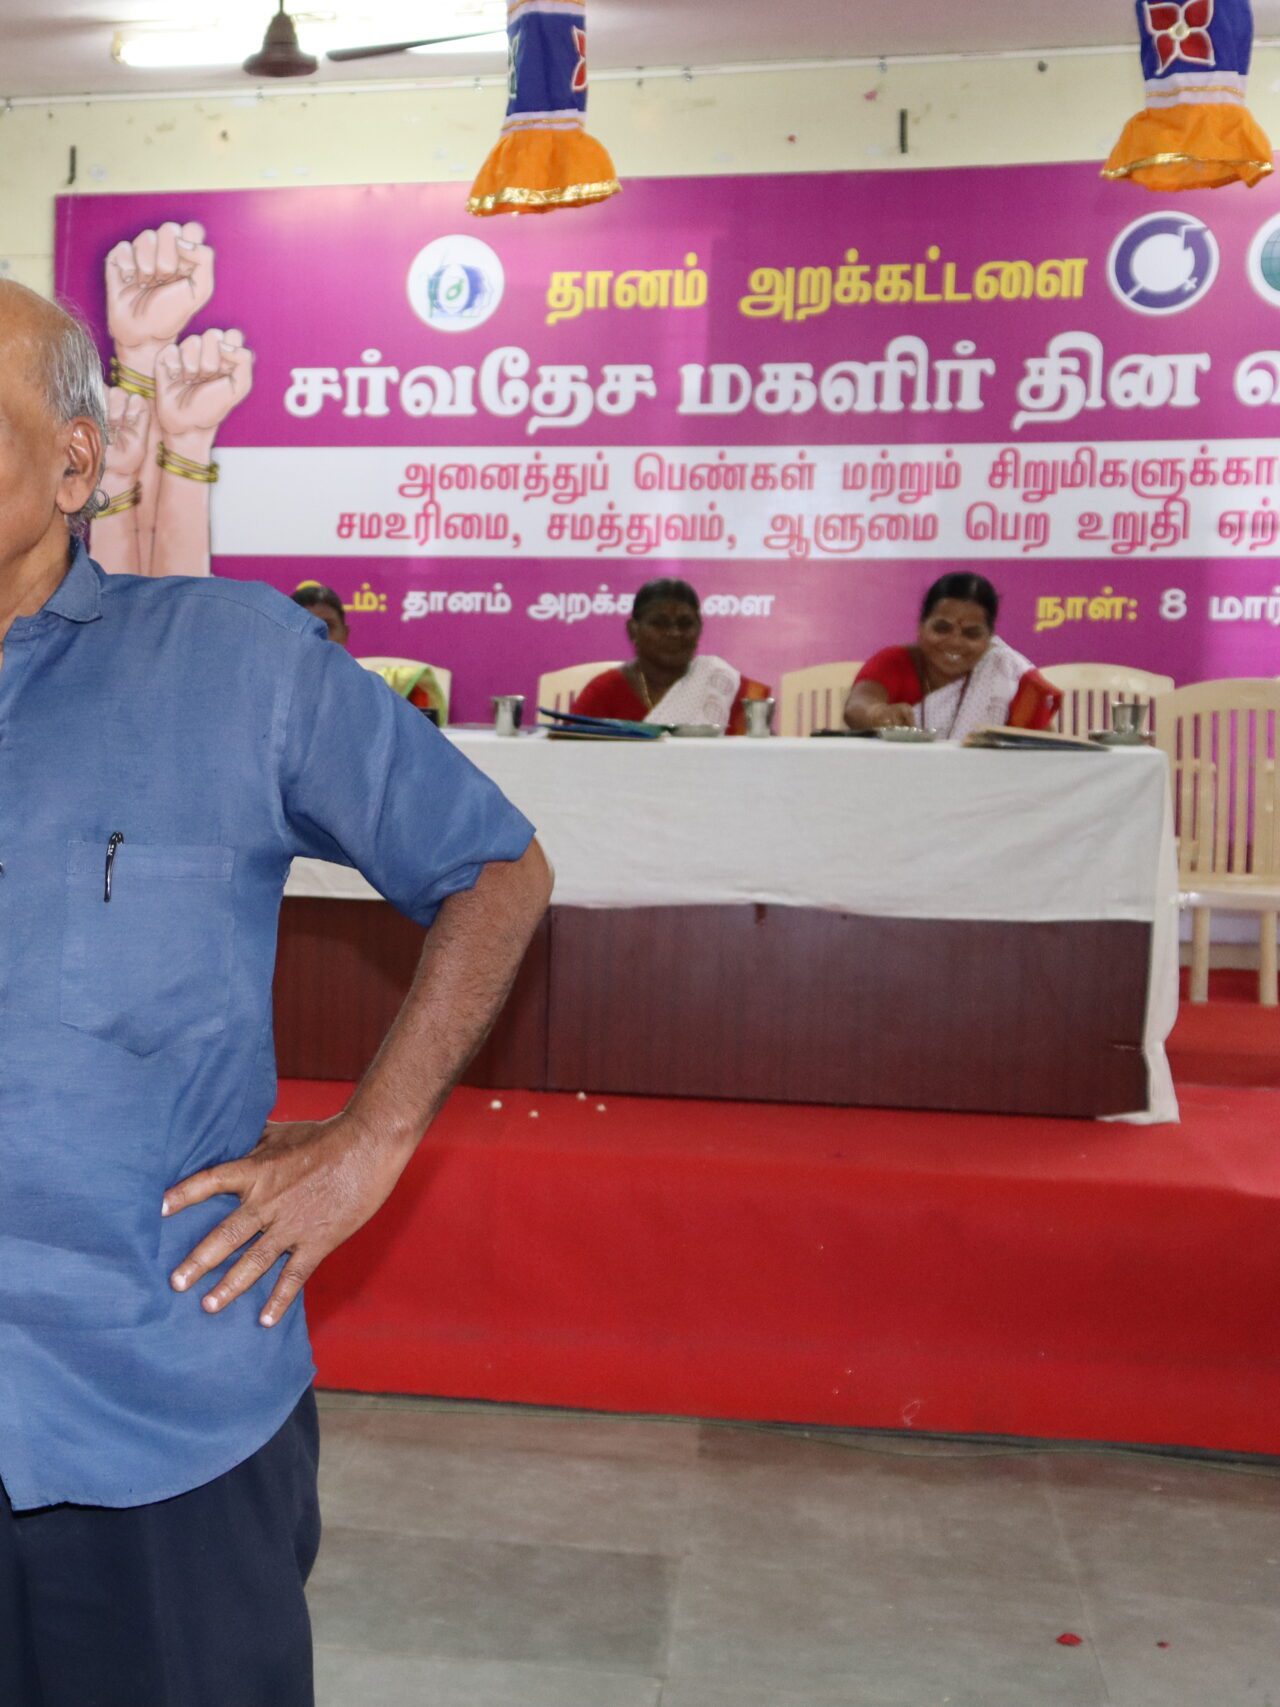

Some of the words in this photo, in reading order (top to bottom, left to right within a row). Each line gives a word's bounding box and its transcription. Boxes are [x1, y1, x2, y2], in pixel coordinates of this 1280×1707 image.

[547, 252, 708, 325] தானம்
[739, 246, 1088, 321] அறக்கட்டளை
[284, 347, 657, 435] சர்வதேச
[677, 335, 996, 415] மகளிர்
[1011, 331, 1211, 431] தின
[398, 452, 610, 504] அனைத்துப்
[633, 450, 816, 492] பெண்கள்
[842, 449, 961, 504] மற்றும்
[988, 445, 1280, 502] சிறுமிகளுக்கா
[336, 502, 522, 548] சமஉரிமை,
[546, 501, 737, 555] சமத்துவம்,
[763, 510, 940, 557] ஆளுமை
[964, 501, 1050, 552] பெற
[1077, 498, 1190, 553] உறுதி
[402, 583, 513, 622] தானம்
[1035, 587, 1138, 632] நாள்:
[1161, 589, 1188, 620] 8
